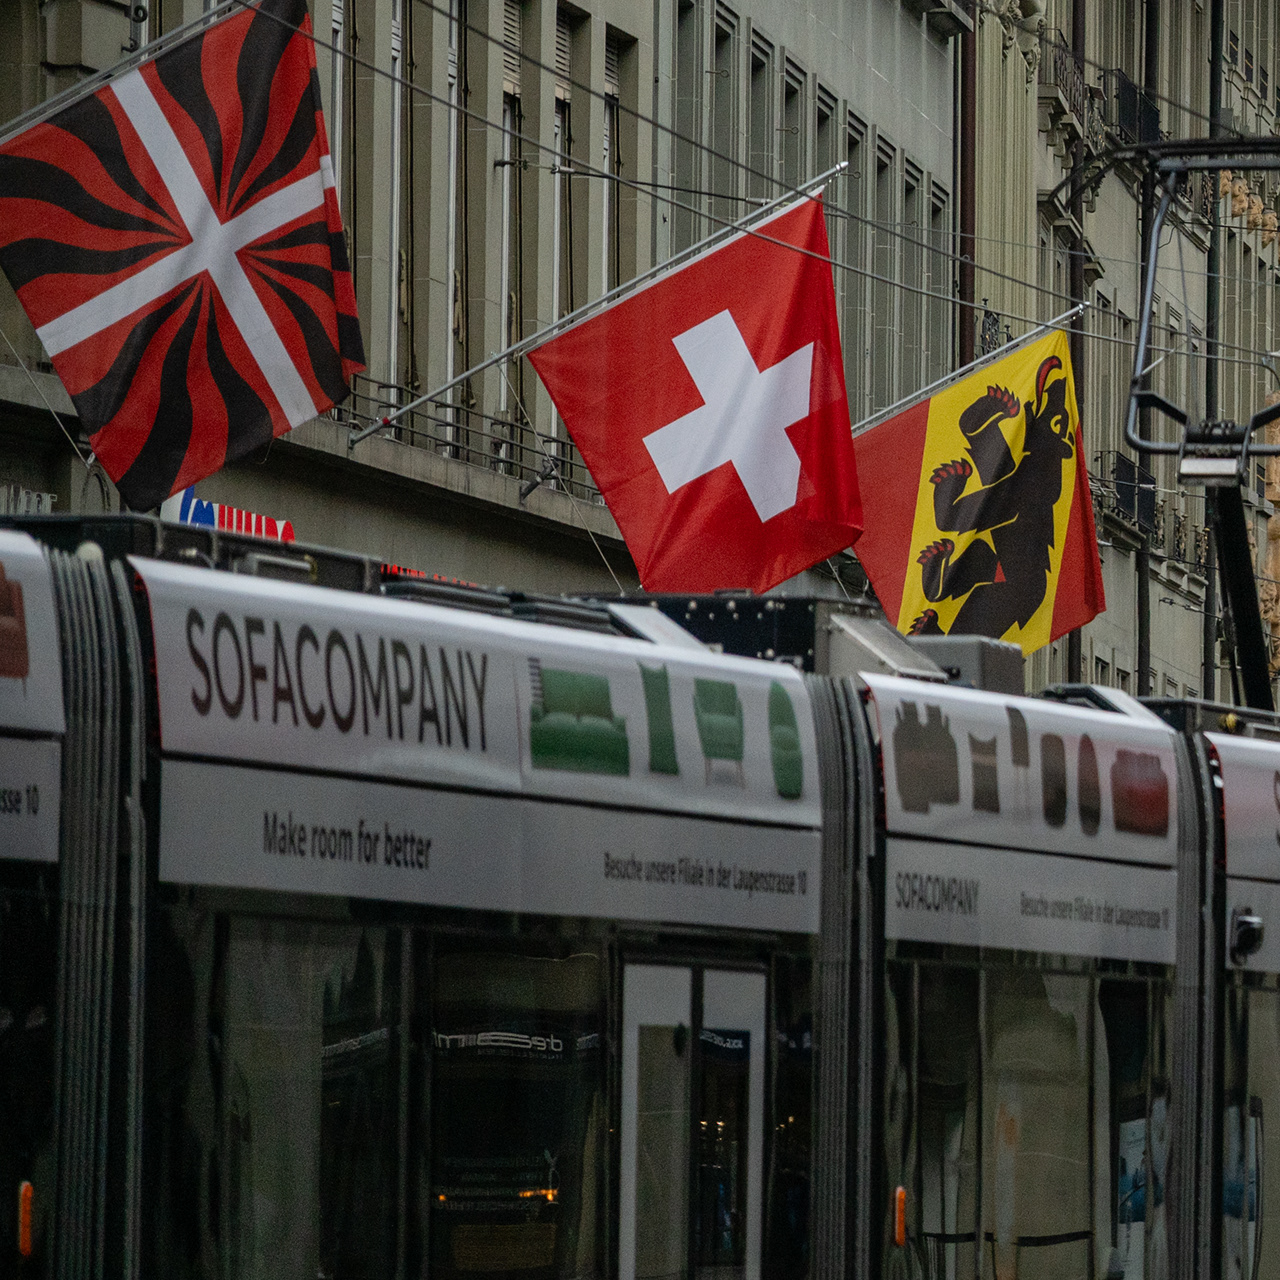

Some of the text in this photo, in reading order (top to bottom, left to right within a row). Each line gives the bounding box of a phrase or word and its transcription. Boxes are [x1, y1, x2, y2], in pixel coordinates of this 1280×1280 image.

[186, 607, 488, 752] SOFACOMPANY
[264, 811, 432, 870] Make room for better
[895, 872, 980, 915] SOFACOMPANY
